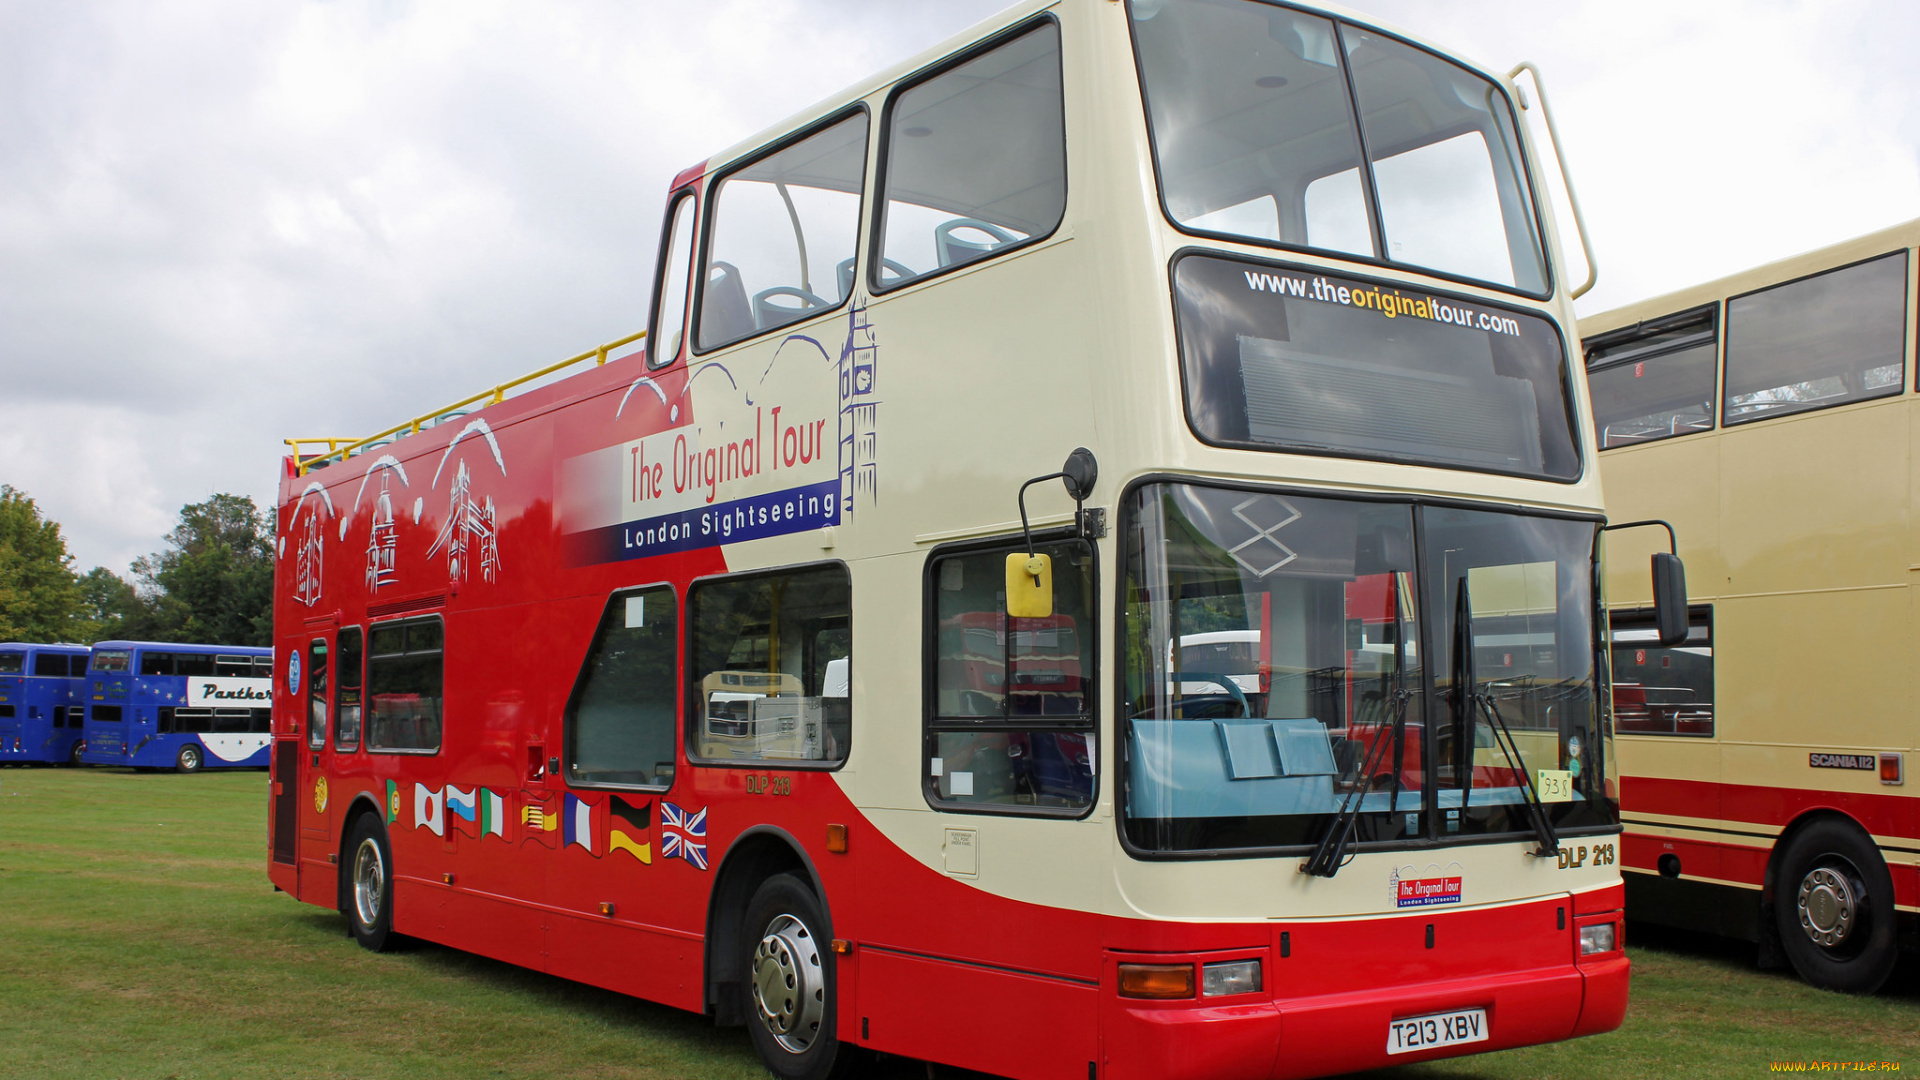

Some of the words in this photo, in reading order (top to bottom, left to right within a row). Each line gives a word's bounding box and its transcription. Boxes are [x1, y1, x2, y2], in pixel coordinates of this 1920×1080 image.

[1244, 271, 1520, 336] www.theoriginaltour.com
[630, 441, 664, 503] The
[673, 406, 761, 504] Original
[771, 405, 826, 471] Tour
[625, 521, 691, 549] London
[701, 492, 834, 537] Sightseeing
[1810, 753, 1858, 768] SCANIA
[1858, 756, 1874, 769] 112
[746, 775, 769, 795] DLP
[772, 776, 791, 797] 213
[1544, 777, 1568, 797] 938
[1558, 846, 1588, 869] DLP
[1592, 843, 1615, 867] 213
[1400, 882, 1413, 896] The
[1415, 878, 1444, 898] Original
[1444, 878, 1460, 892] Tour
[1424, 896, 1459, 905] Sightseeing
[1392, 1019, 1438, 1048] T213
[1442, 1013, 1479, 1041] XBV
